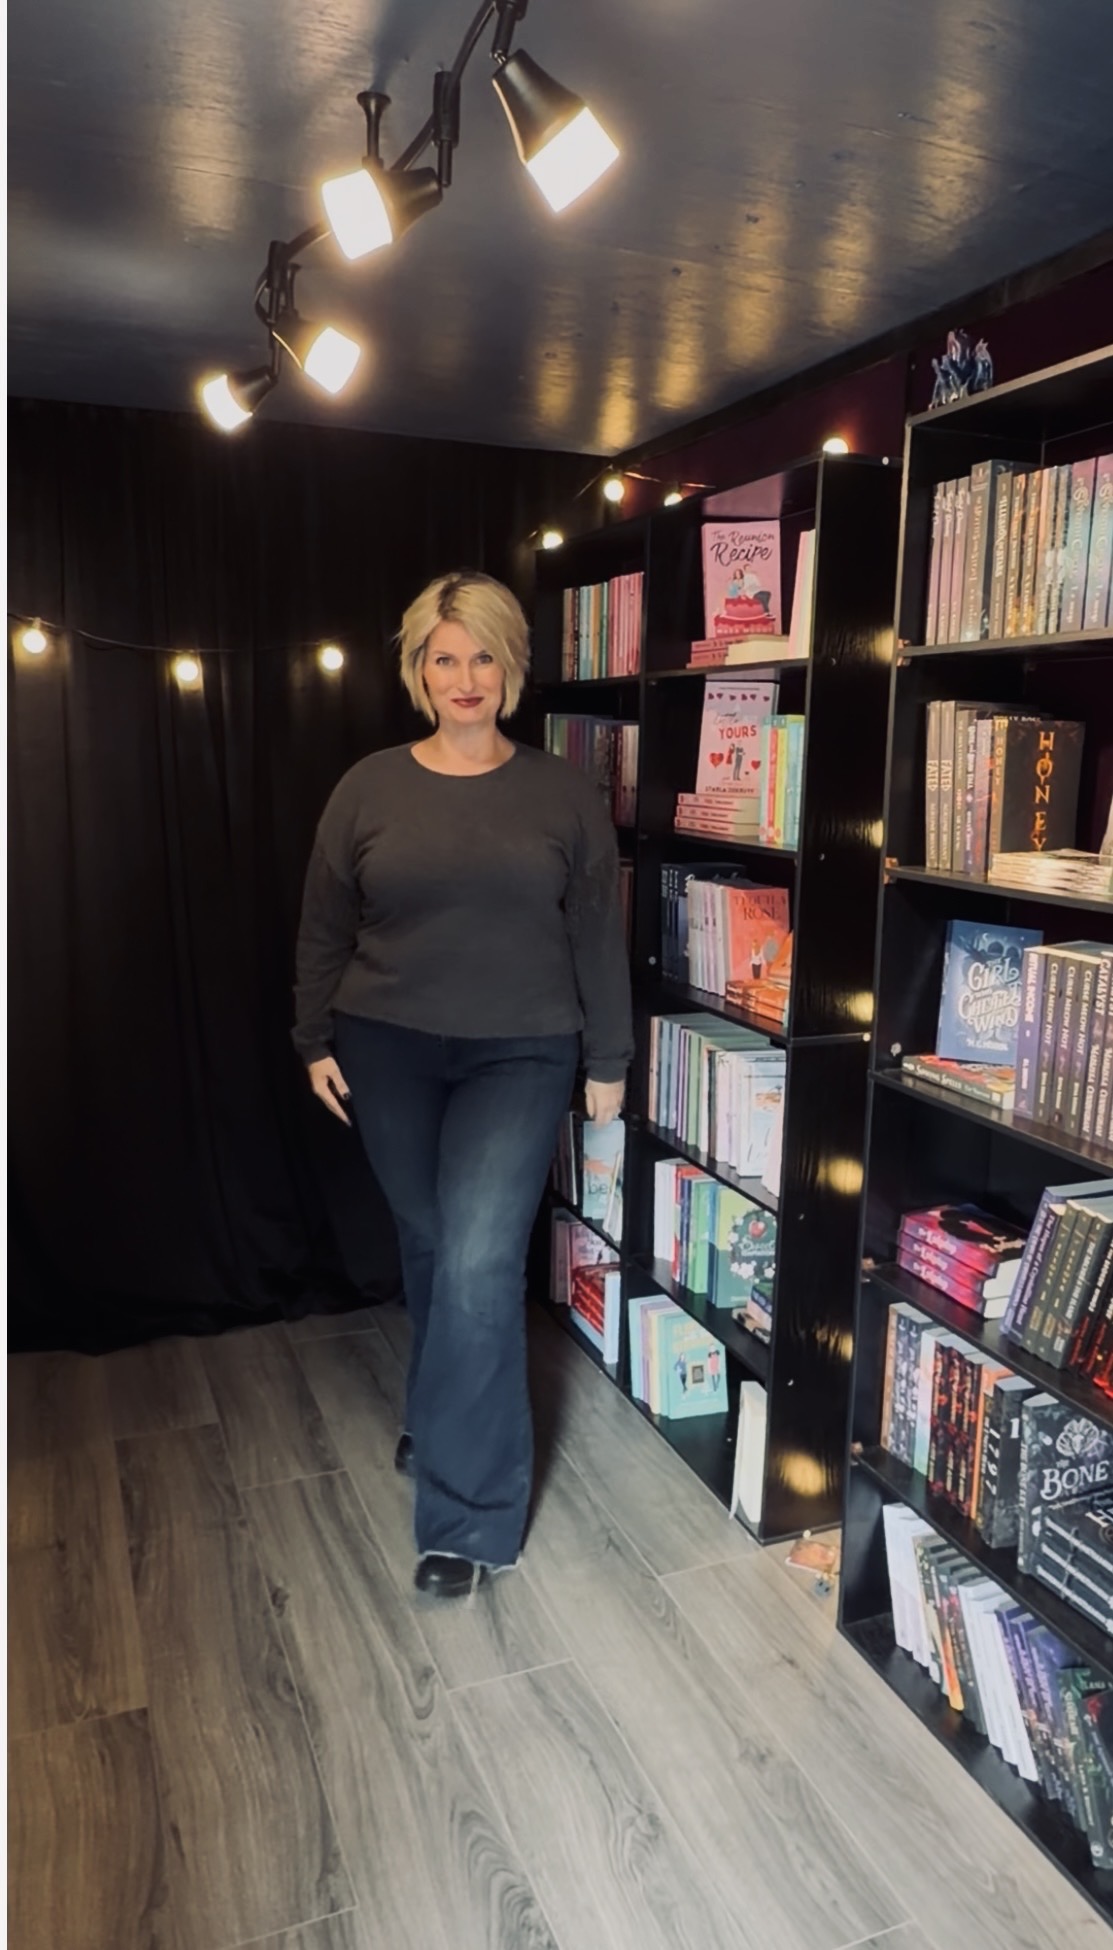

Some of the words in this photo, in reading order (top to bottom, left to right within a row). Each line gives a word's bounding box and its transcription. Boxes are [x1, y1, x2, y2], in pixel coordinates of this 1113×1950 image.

[728, 530, 775, 546] Reunion
[710, 541, 773, 567] Recipe
[719, 724, 757, 740] YOURS
[927, 759, 939, 792] FATED
[941, 759, 953, 792] FATED
[1032, 731, 1055, 851] HONEY
[968, 958, 1020, 991] GIRL
[1048, 963, 1058, 993] CURSE
[1065, 966, 1076, 997] CURSE
[1082, 970, 1093, 1002] CURSE
[1095, 958, 1112, 1016] CATALYST
[967, 1006, 1018, 1033] WIND
[1046, 992, 1056, 1024] MEOW
[1063, 997, 1073, 1028] MEOW
[1079, 1001, 1089, 1034] MEOW
[1044, 1023, 1053, 1045] NOT
[1060, 1027, 1070, 1050] NOT
[1076, 1033, 1086, 1056] NOT
[1040, 1460, 1110, 1500] BONE
